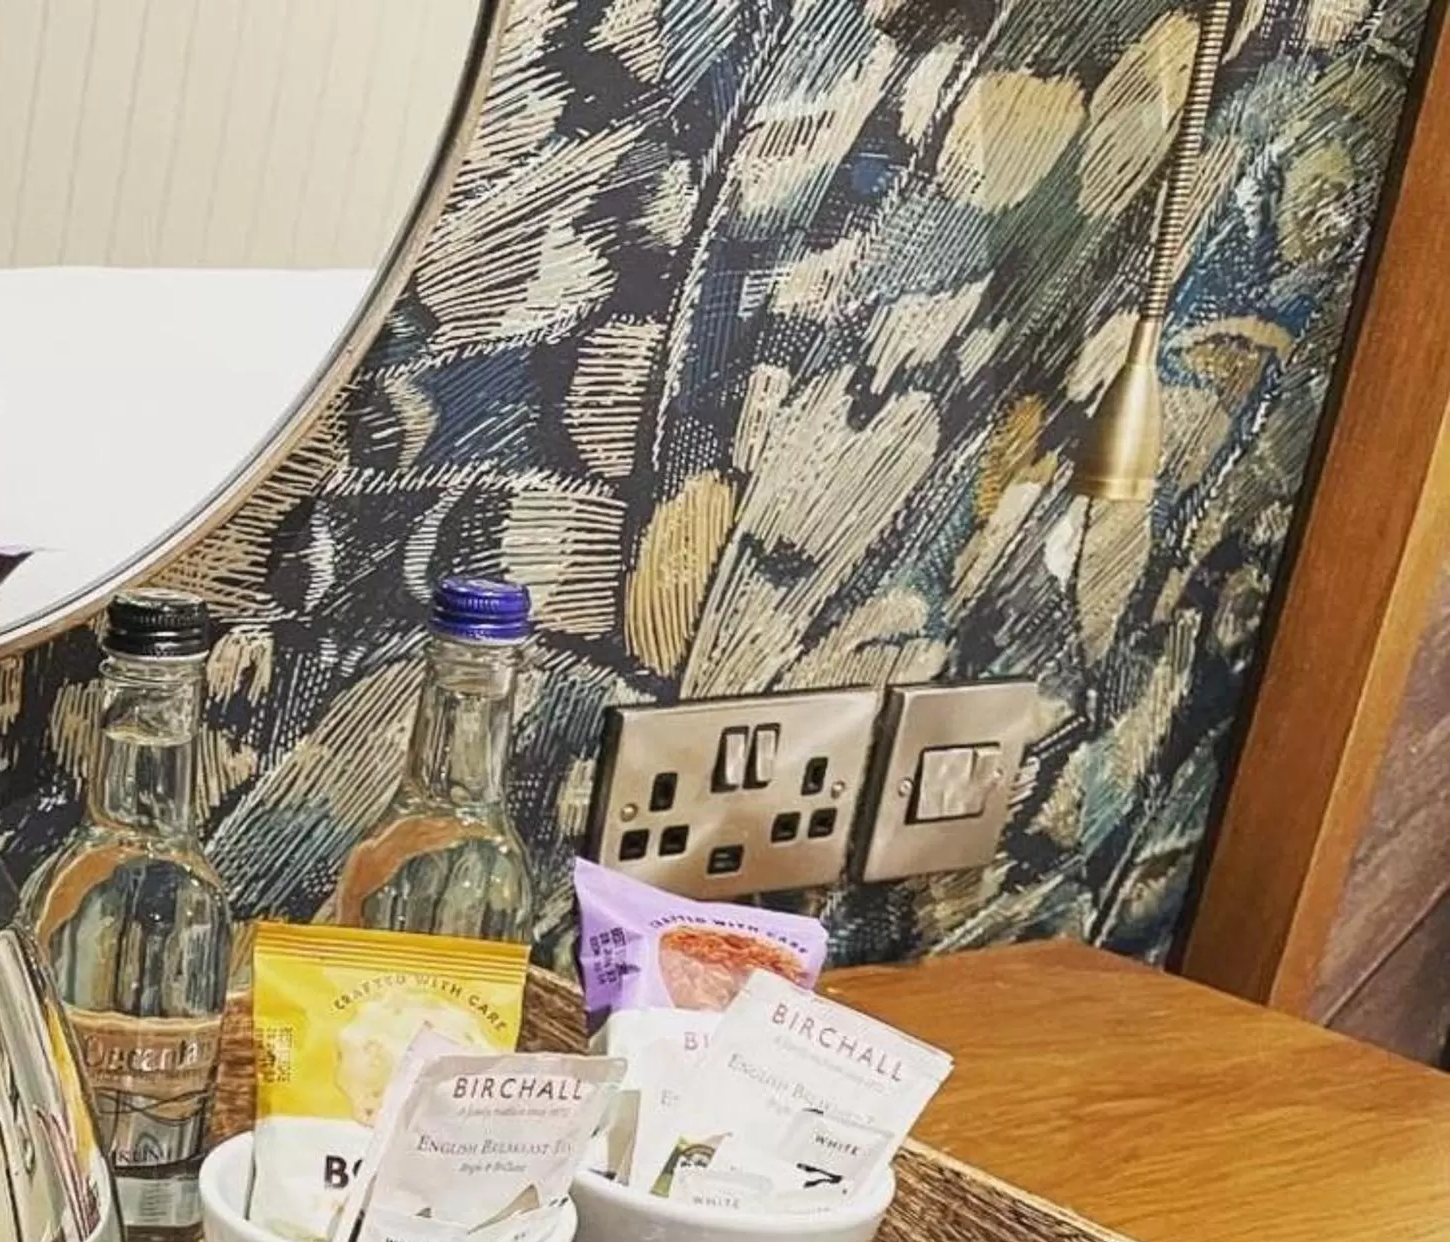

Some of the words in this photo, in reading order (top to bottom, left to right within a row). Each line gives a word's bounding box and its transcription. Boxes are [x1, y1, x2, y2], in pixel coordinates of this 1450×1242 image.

[333, 974, 407, 1011] CRAFTED
[415, 973, 463, 997] WITH
[467, 994, 508, 1031] CARE
[770, 1002, 904, 1082] BIRCHALL
[452, 1076, 584, 1101] BIRCHALL
[814, 1133, 860, 1156] WHITE
